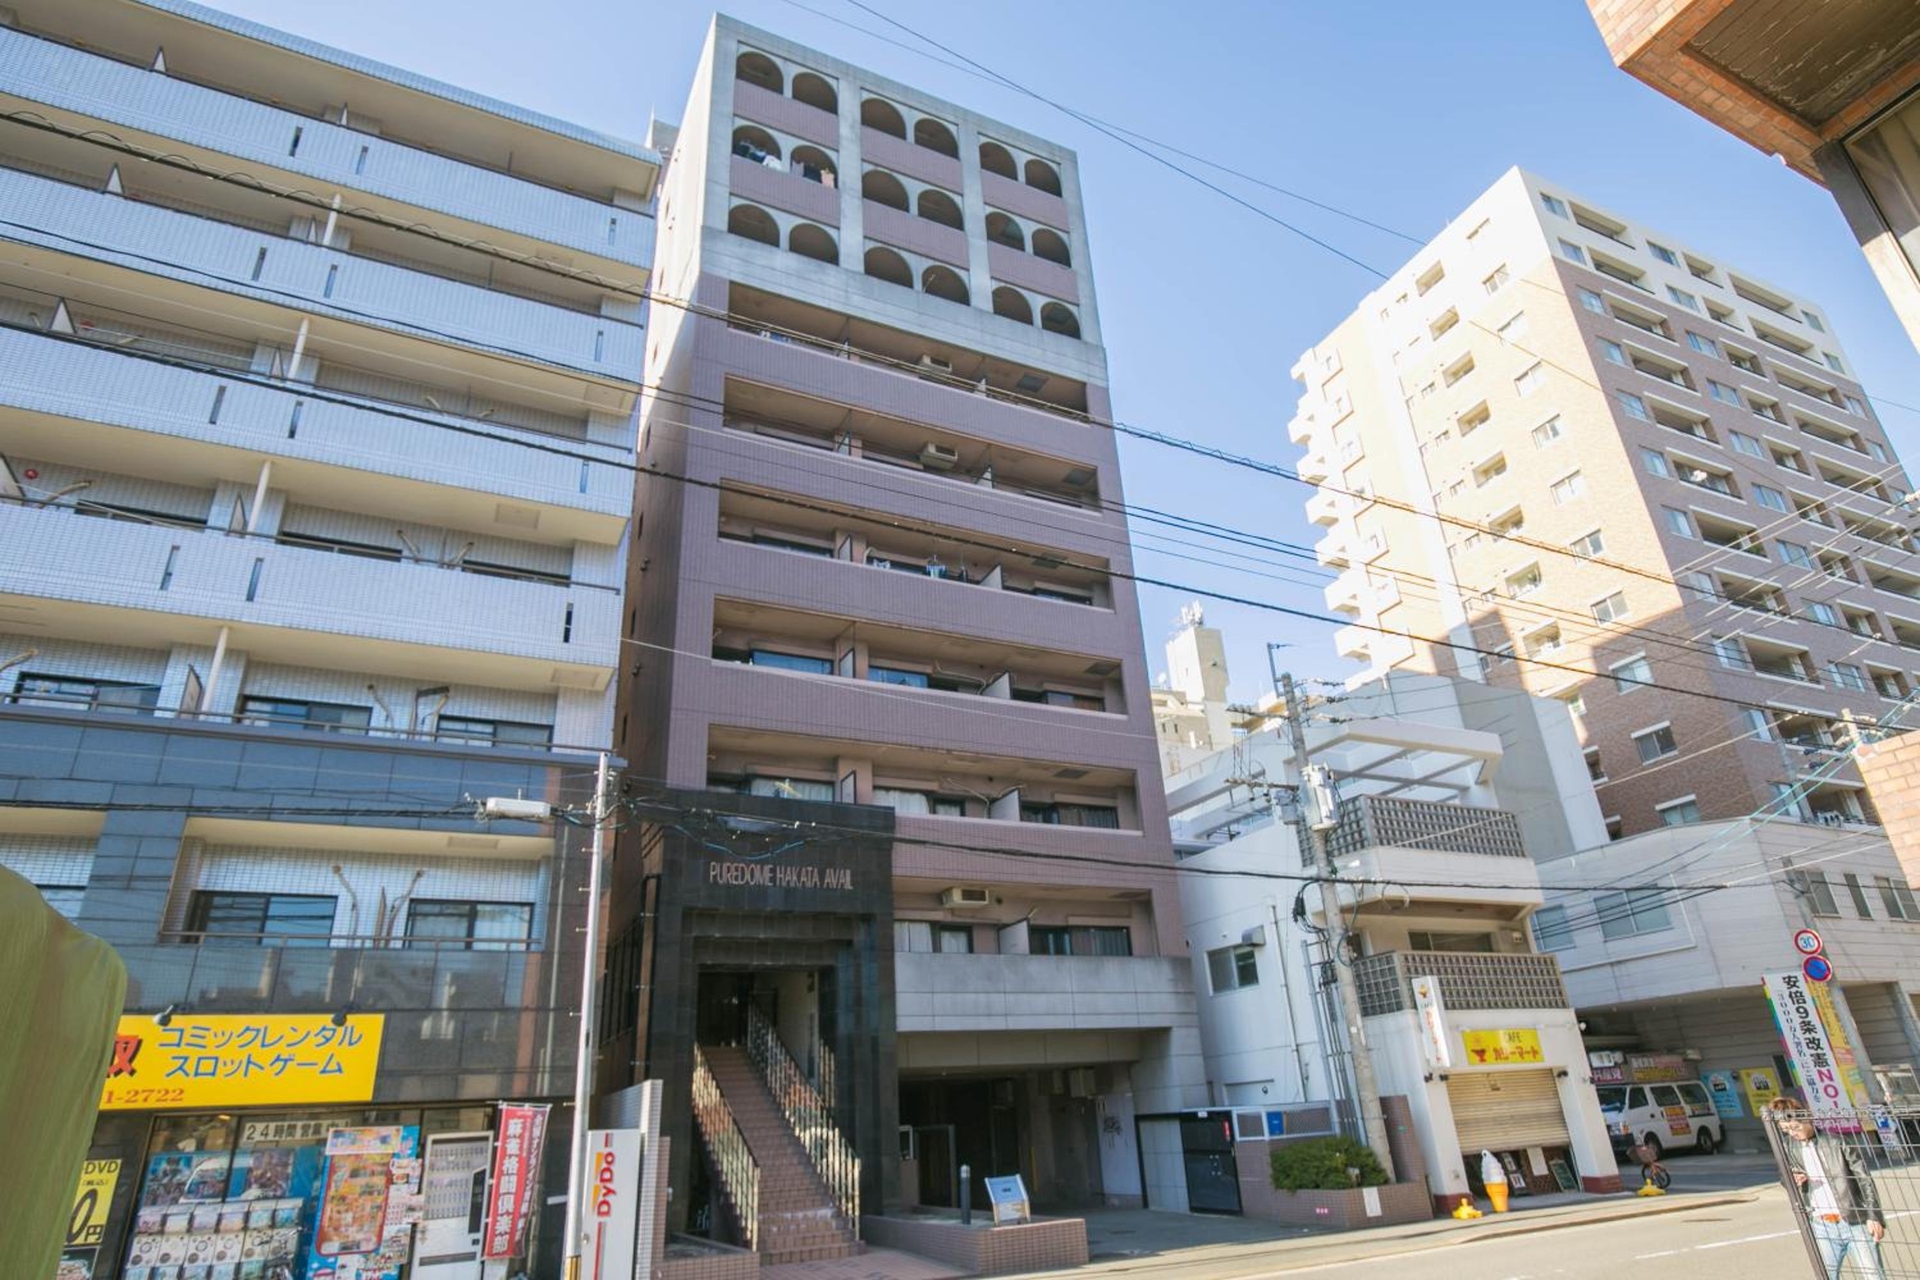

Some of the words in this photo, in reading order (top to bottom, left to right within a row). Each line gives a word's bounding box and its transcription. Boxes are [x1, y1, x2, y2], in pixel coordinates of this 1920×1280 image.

[709, 861, 773, 886] PUREDOME
[776, 866, 819, 888] HAKATA
[1801, 936, 1816, 949] 30
[157, 1024, 363, 1049] コミックレンタル
[165, 1053, 343, 1079] スロットゲーム
[597, 1152, 616, 1217] DyDo
